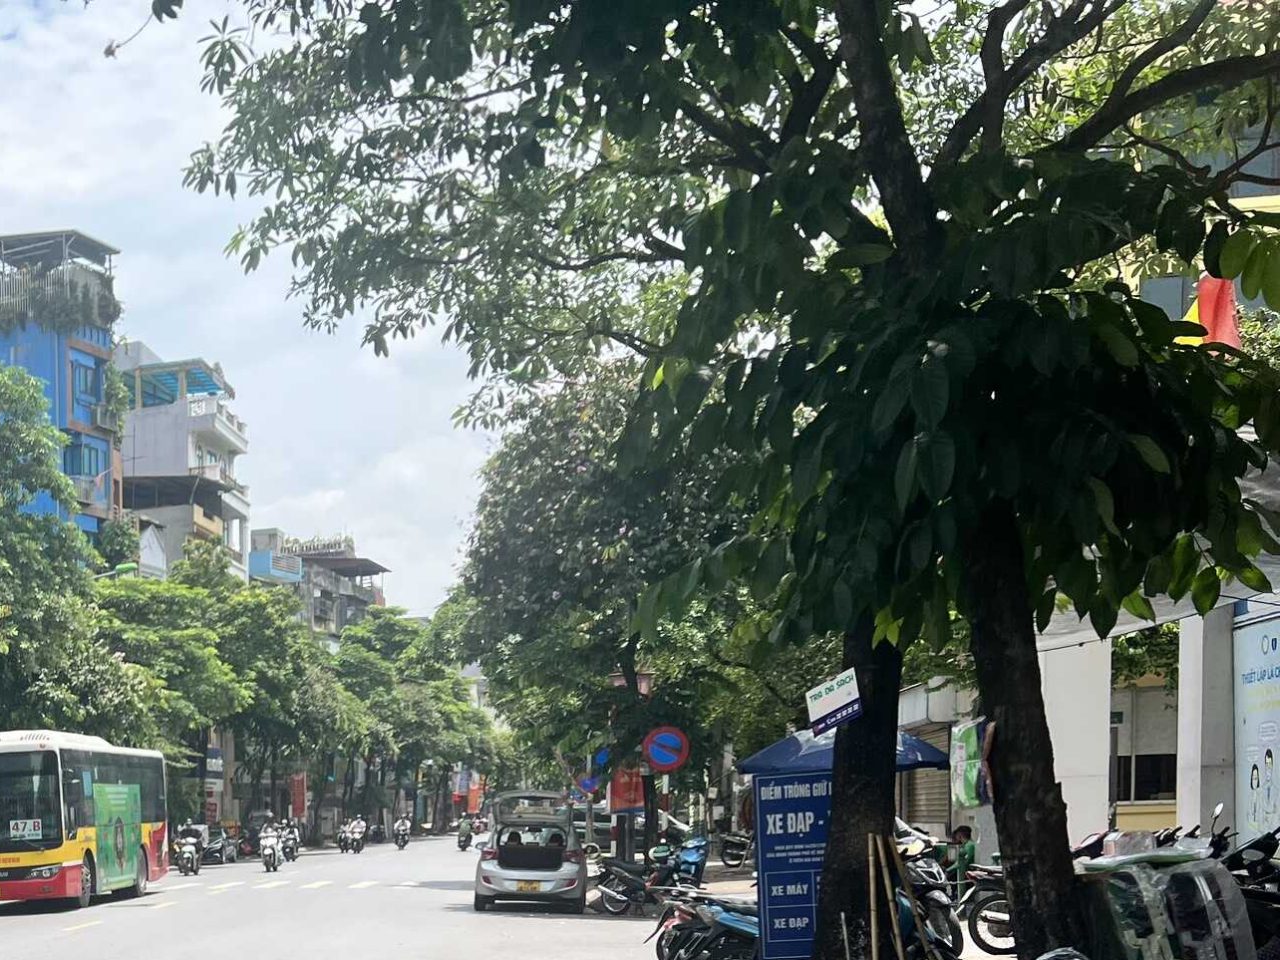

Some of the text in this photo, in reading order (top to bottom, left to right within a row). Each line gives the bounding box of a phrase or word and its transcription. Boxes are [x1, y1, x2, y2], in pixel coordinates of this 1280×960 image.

[760, 781, 827, 801] ĐIỂM TRÔNG GIỮ
[766, 811, 815, 838] XE ĐẠP
[771, 881, 809, 897] XE MÁY
[773, 915, 810, 932] XE ĐẠP
